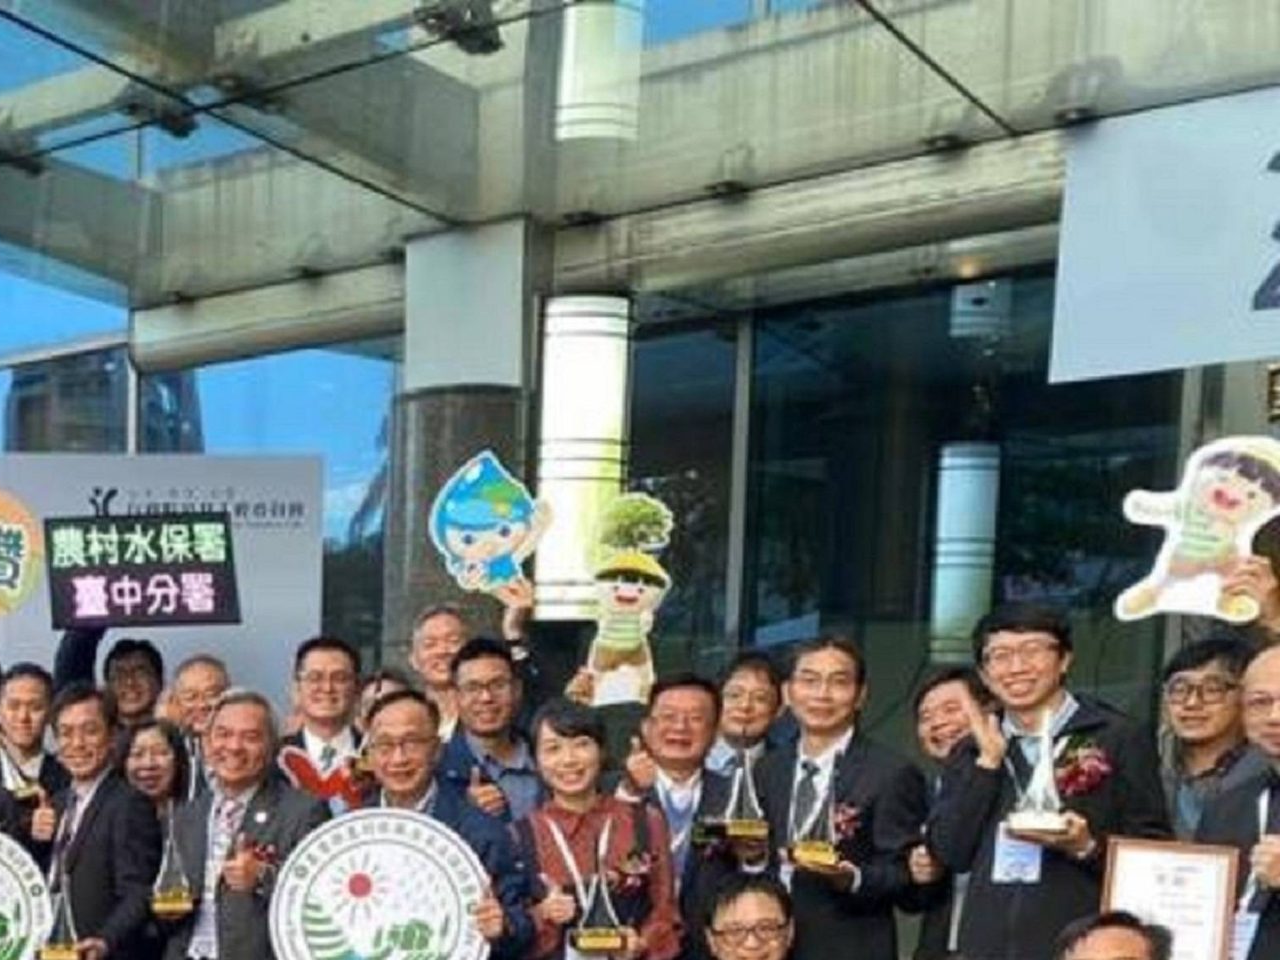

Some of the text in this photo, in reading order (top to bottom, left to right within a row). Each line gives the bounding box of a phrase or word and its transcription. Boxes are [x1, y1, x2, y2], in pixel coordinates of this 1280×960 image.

[52, 522, 227, 567] 農村水保署
[72, 572, 215, 618] 臺中分署
